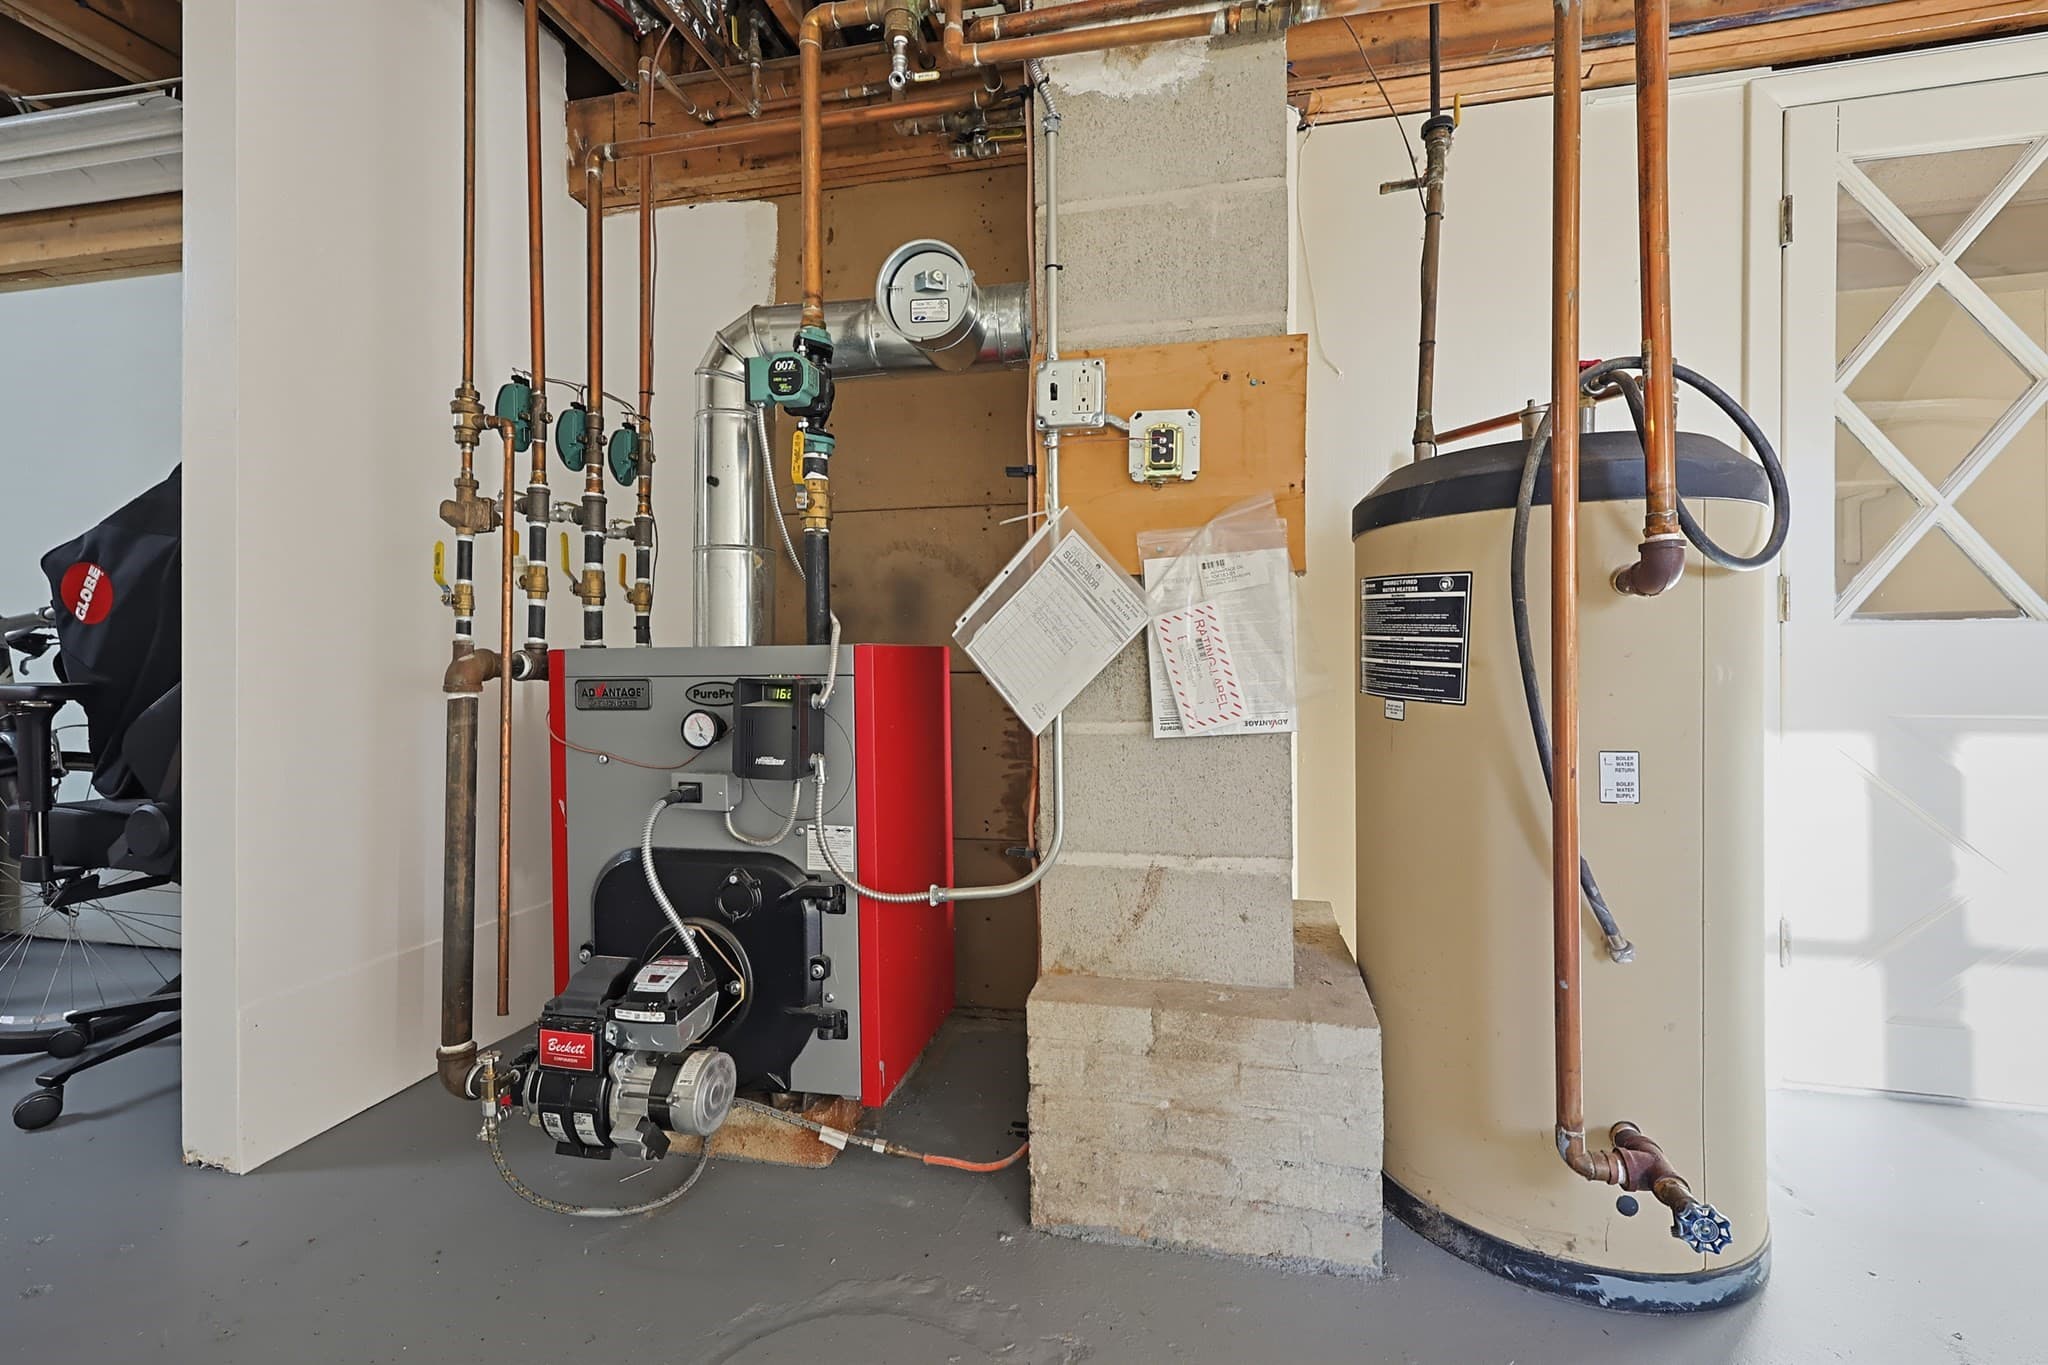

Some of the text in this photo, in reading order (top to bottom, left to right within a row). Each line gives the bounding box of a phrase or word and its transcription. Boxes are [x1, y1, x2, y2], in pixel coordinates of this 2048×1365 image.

[1062, 550, 1100, 591] SUPERIOR
[75, 564, 101, 621] GLOBE
[1194, 619, 1217, 666] RATING
[582, 681, 642, 697] ADVANTAGE
[1244, 719, 1288, 729] ADVANTAGE
[548, 1037, 586, 1054] Beckett
